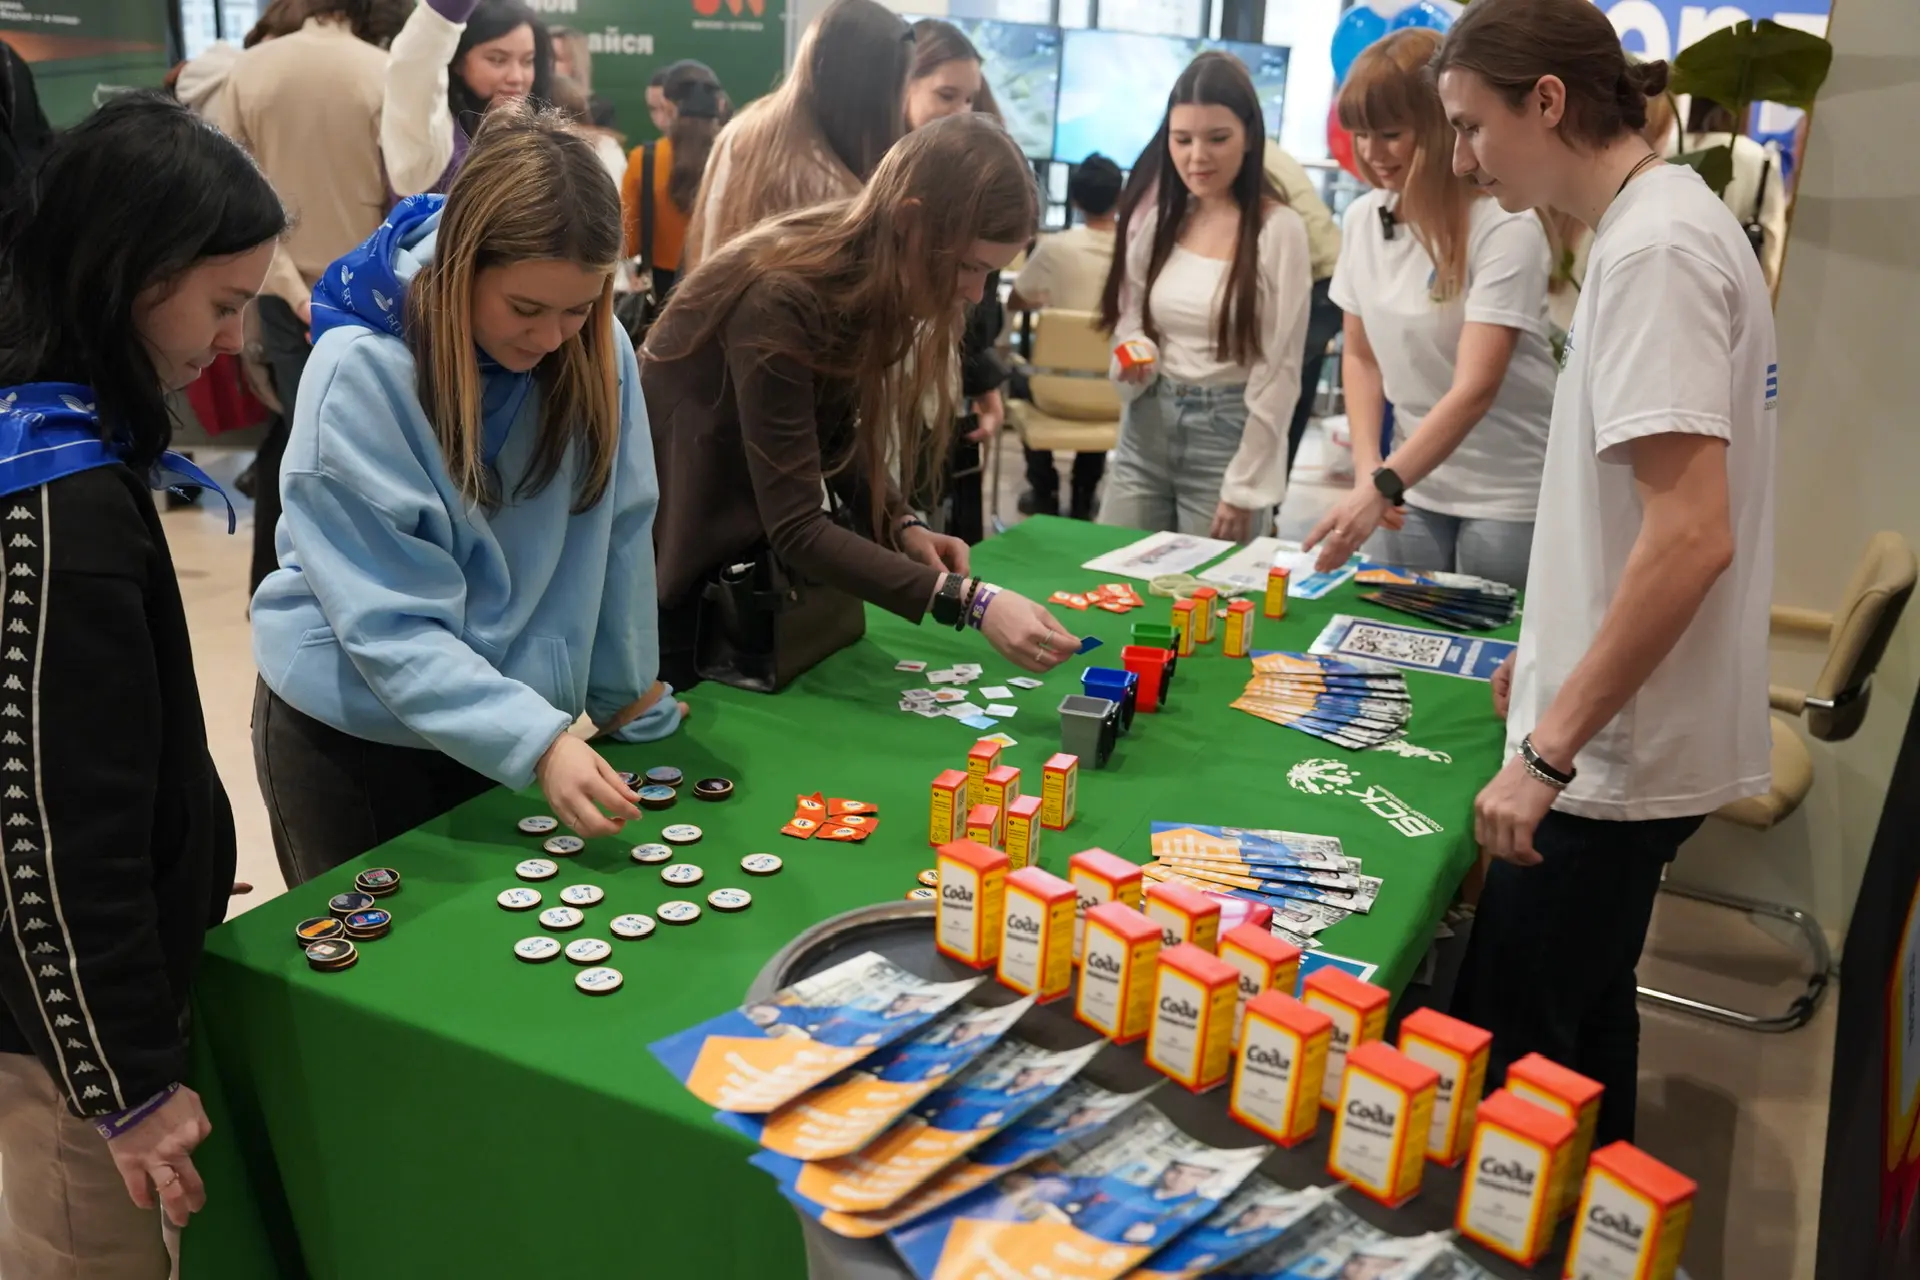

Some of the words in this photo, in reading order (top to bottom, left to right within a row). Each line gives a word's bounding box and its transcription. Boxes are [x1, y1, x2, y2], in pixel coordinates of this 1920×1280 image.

[942, 884, 974, 902] Сода
[1007, 914, 1040, 932] Сода
[1088, 952, 1120, 974] Сода
[1160, 996, 1198, 1020] Сода
[1247, 1045, 1291, 1070] Сода
[1348, 1099, 1396, 1127] Сода
[1480, 1157, 1535, 1185] Сода
[1589, 1204, 1643, 1240] Сода
